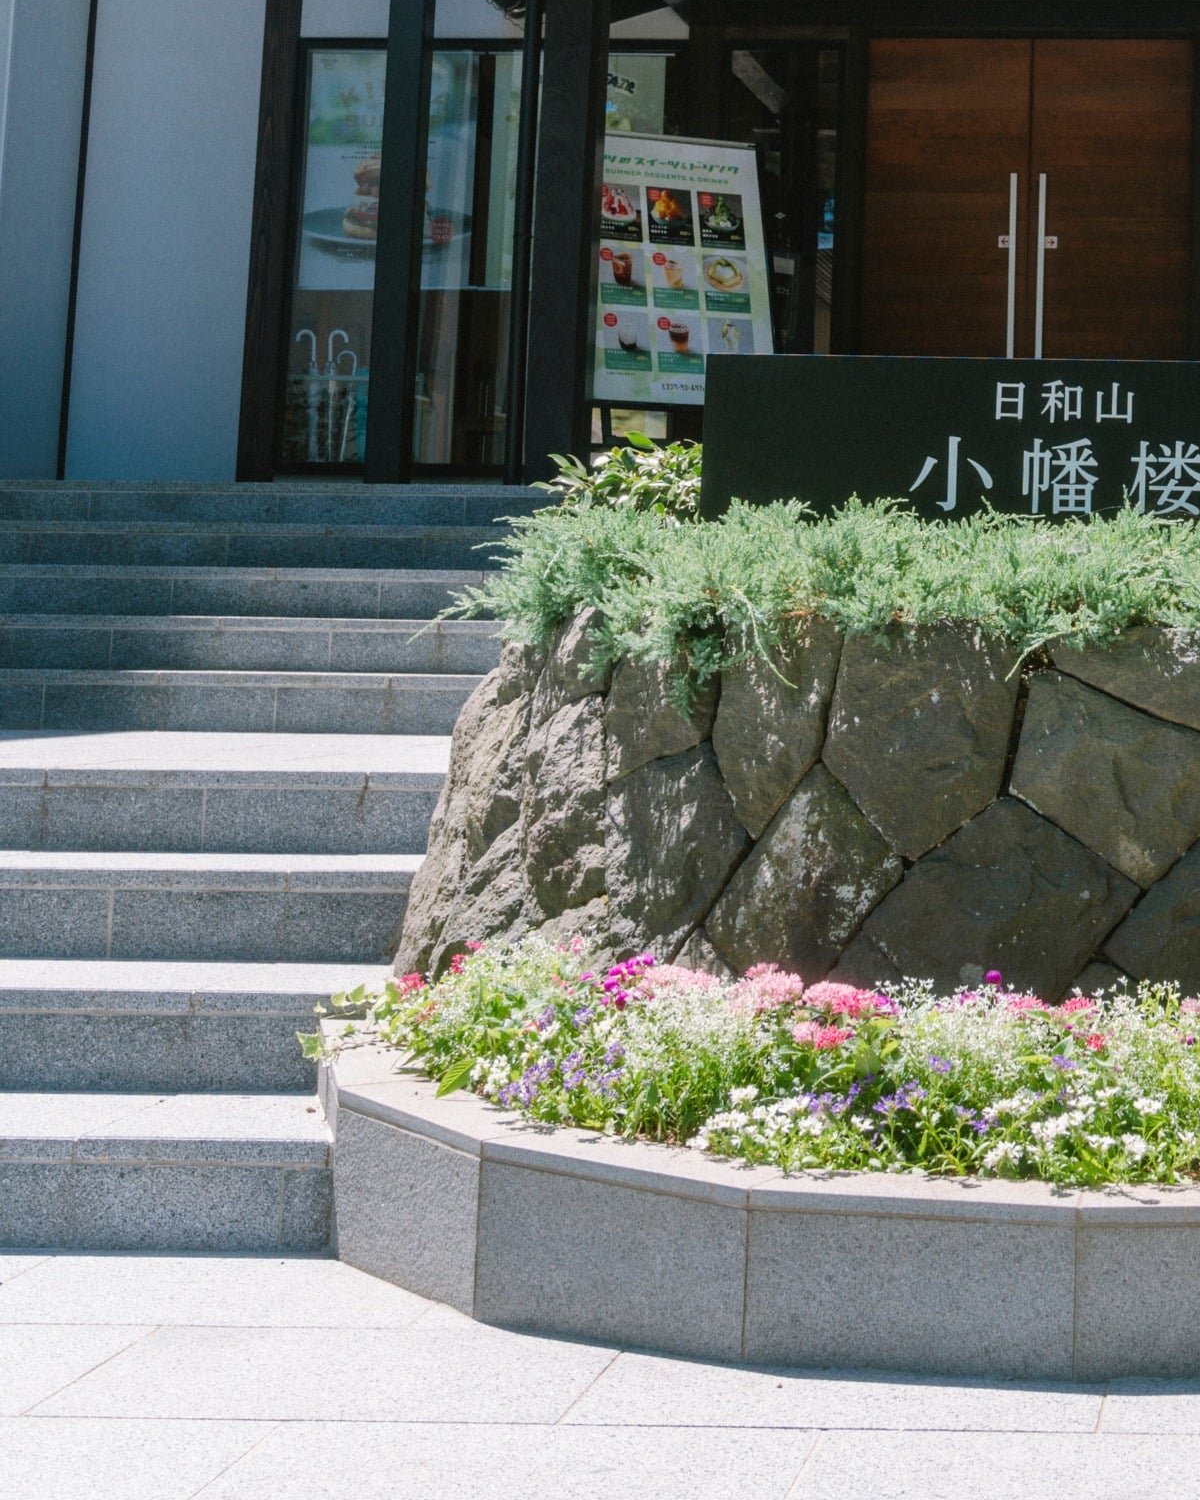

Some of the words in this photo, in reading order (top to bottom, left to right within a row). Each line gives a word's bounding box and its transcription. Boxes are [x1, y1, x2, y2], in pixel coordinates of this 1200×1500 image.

[605, 168, 641, 176] SUMMER
[993, 378, 1136, 425] 日和山
